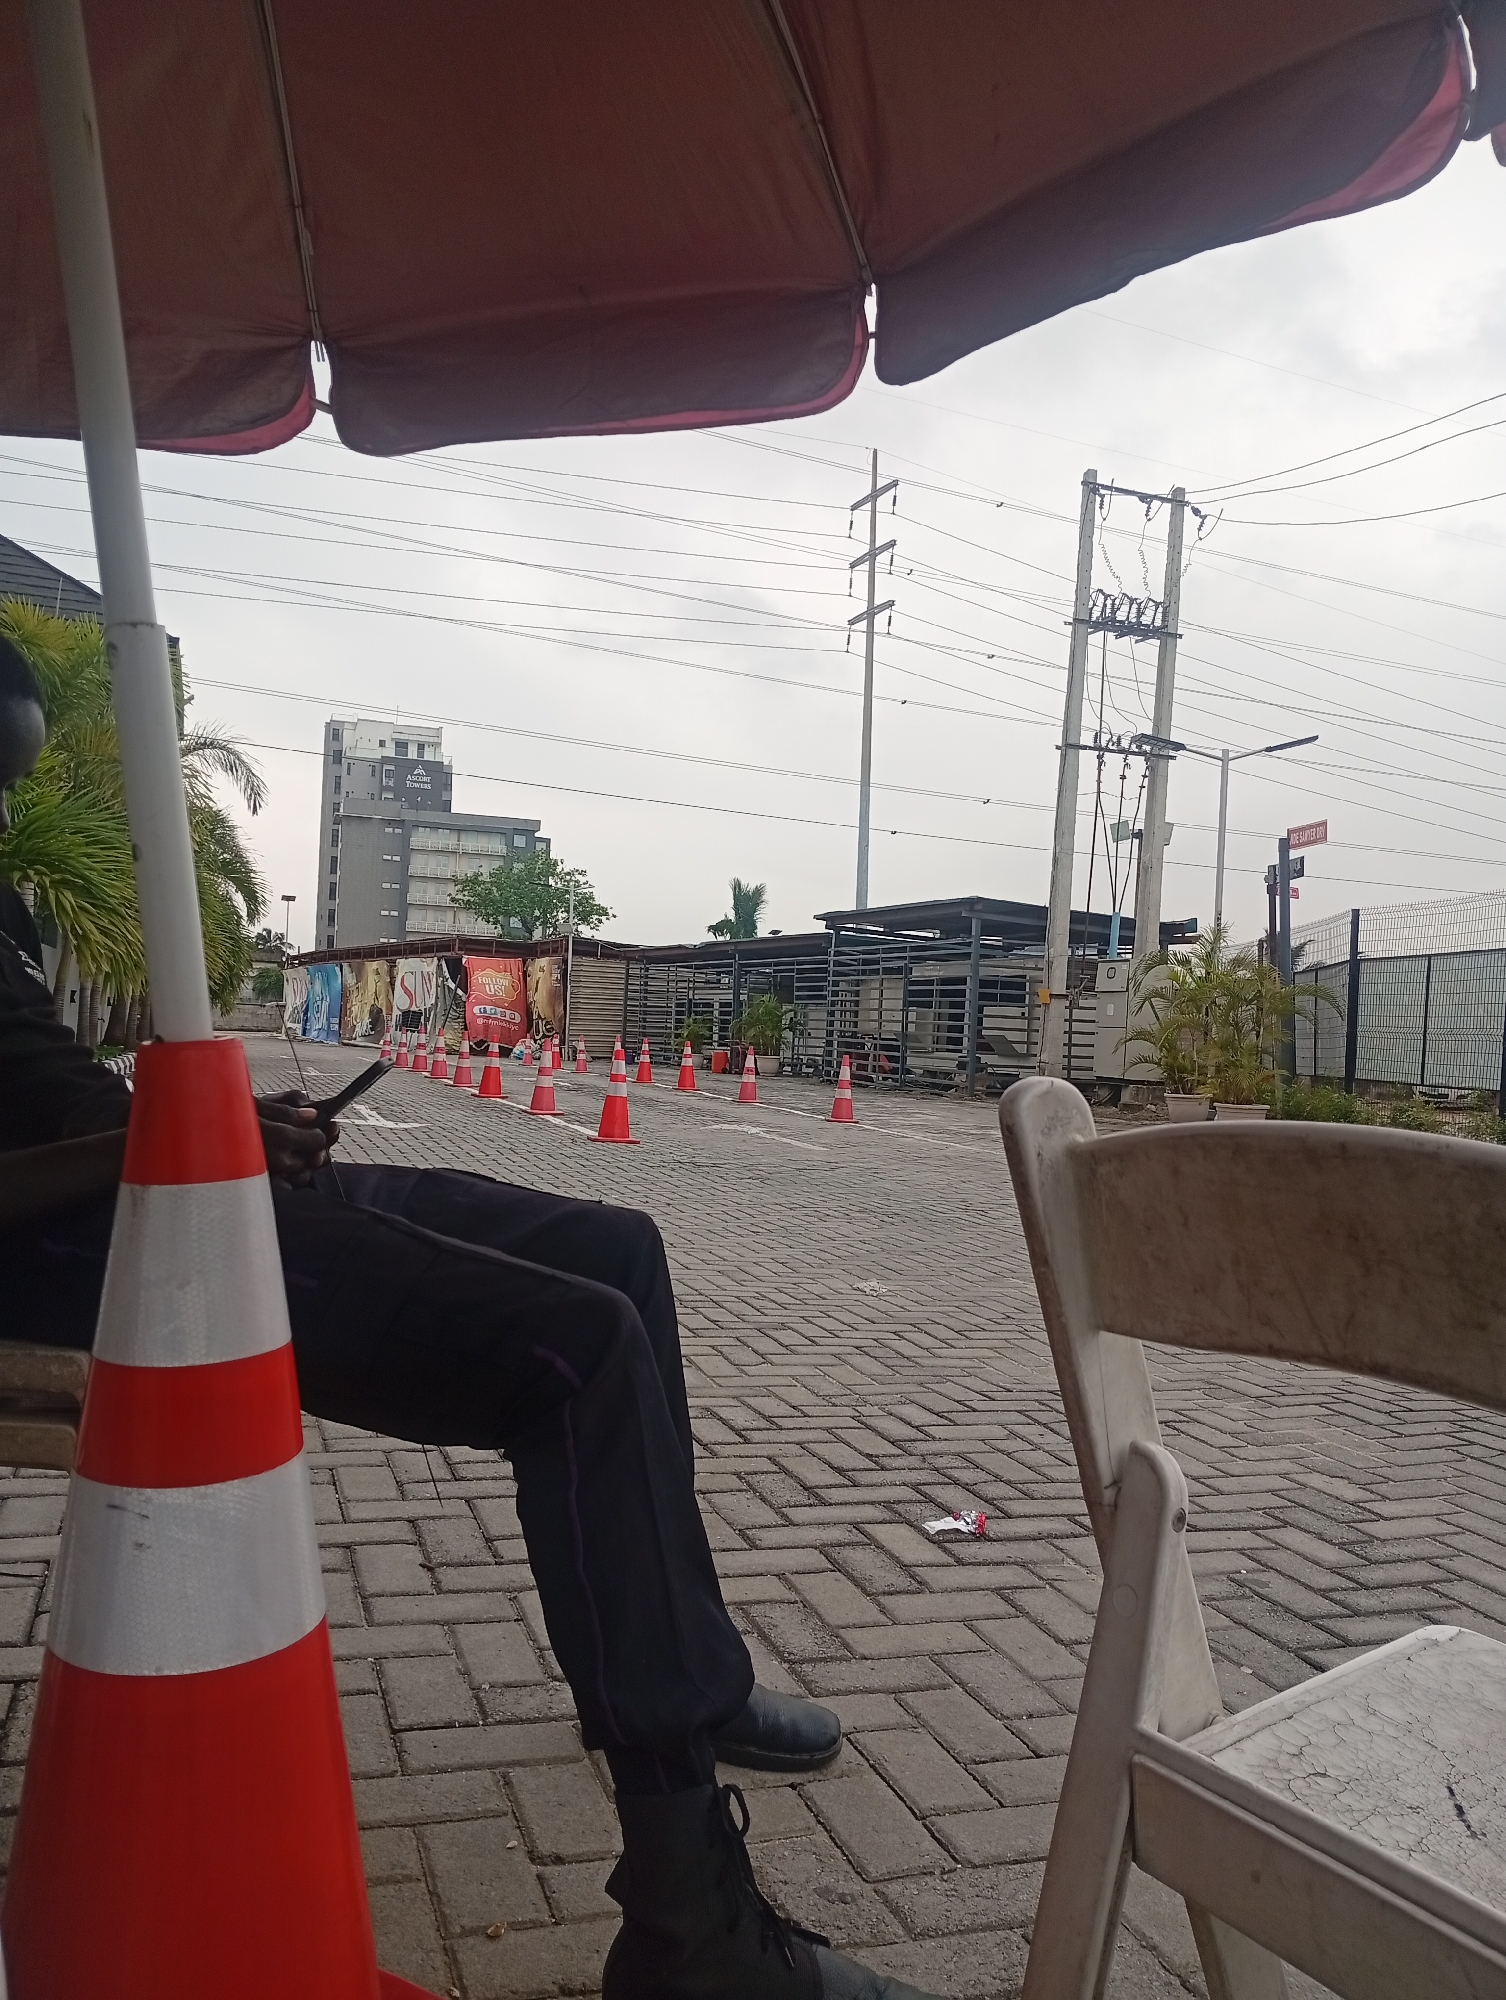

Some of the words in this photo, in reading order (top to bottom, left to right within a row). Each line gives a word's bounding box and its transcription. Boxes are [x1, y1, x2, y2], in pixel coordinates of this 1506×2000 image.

[406, 781, 432, 789] TOWERS
[478, 976, 509, 987] FOLLOW
[485, 983, 505, 997] US!
